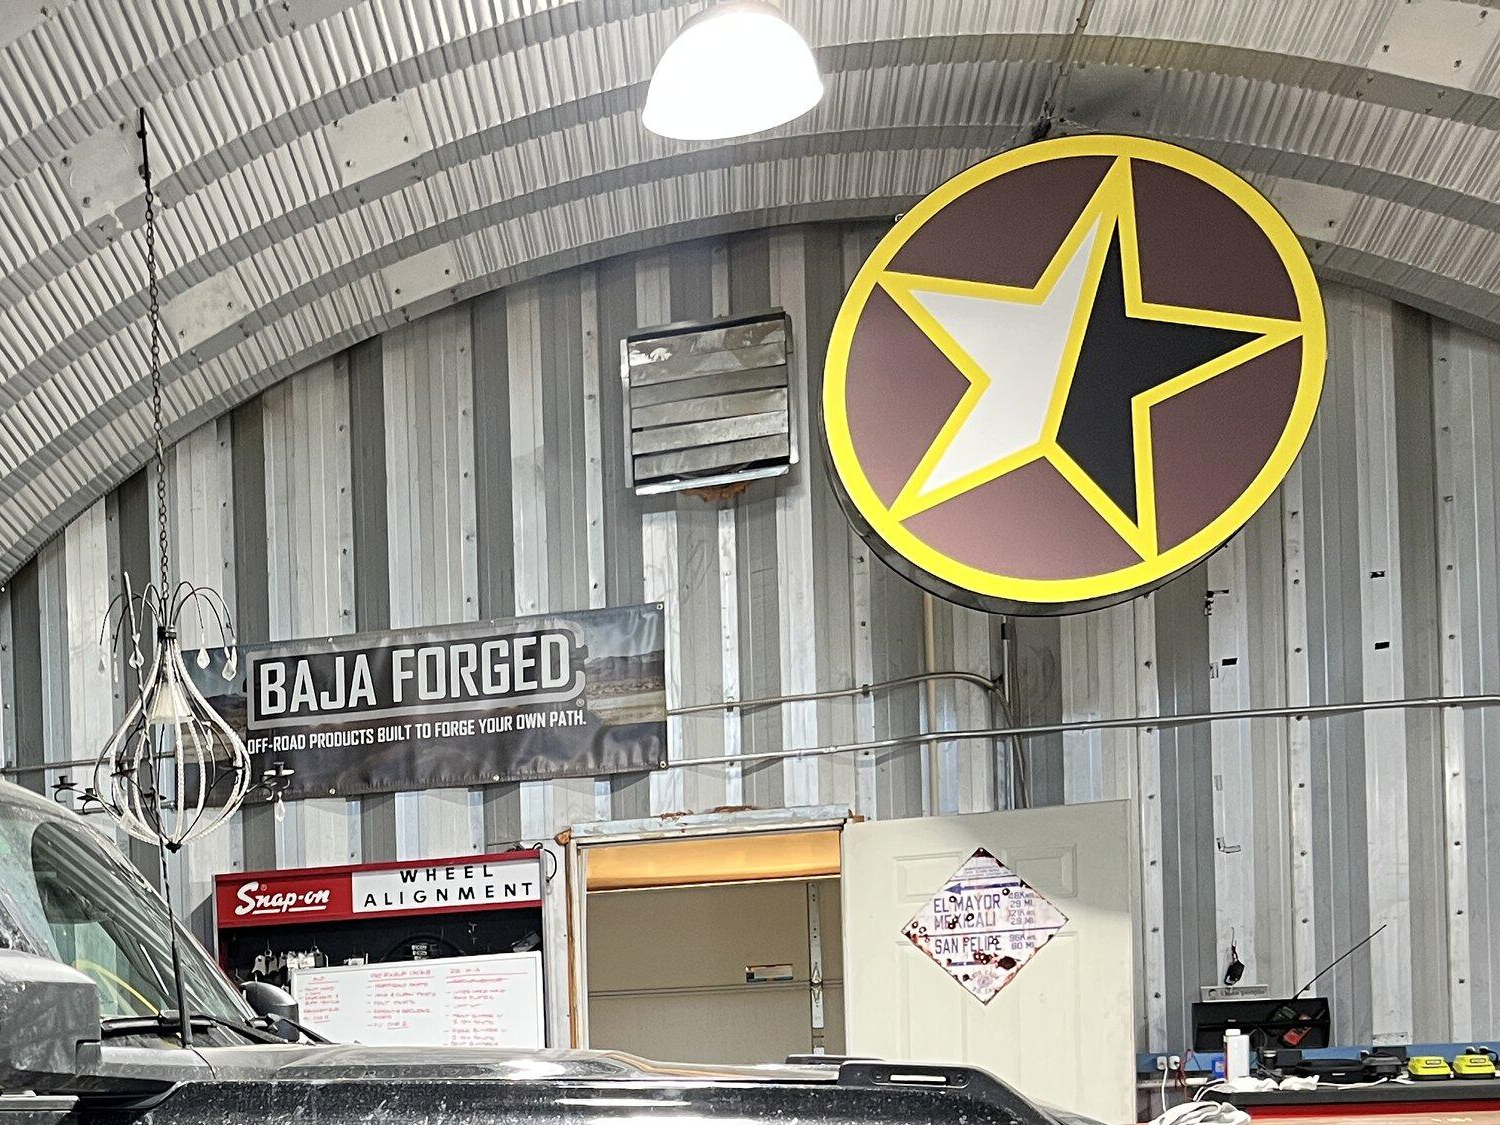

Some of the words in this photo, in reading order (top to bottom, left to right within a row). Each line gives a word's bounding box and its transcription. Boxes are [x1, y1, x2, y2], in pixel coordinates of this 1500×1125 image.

[260, 653, 377, 716] BAJA
[392, 634, 570, 702] FORGED
[247, 734, 306, 755] OFF-ROAD
[309, 728, 375, 749] PRODUCTS
[377, 724, 412, 743] BUILT
[415, 723, 432, 739] TO
[435, 719, 475, 738] FORGE
[478, 715, 513, 734] YOUR
[516, 712, 546, 730] OWN
[549, 709, 587, 728] PATH.
[400, 864, 493, 884] WHEEL
[235, 881, 331, 915] Snap-on
[364, 882, 533, 907] ALIGNMENT
[933, 898, 949, 913] EL
[954, 893, 1001, 911] MAYOR
[935, 937, 959, 954] SAN
[962, 935, 1002, 952] FELIPE
